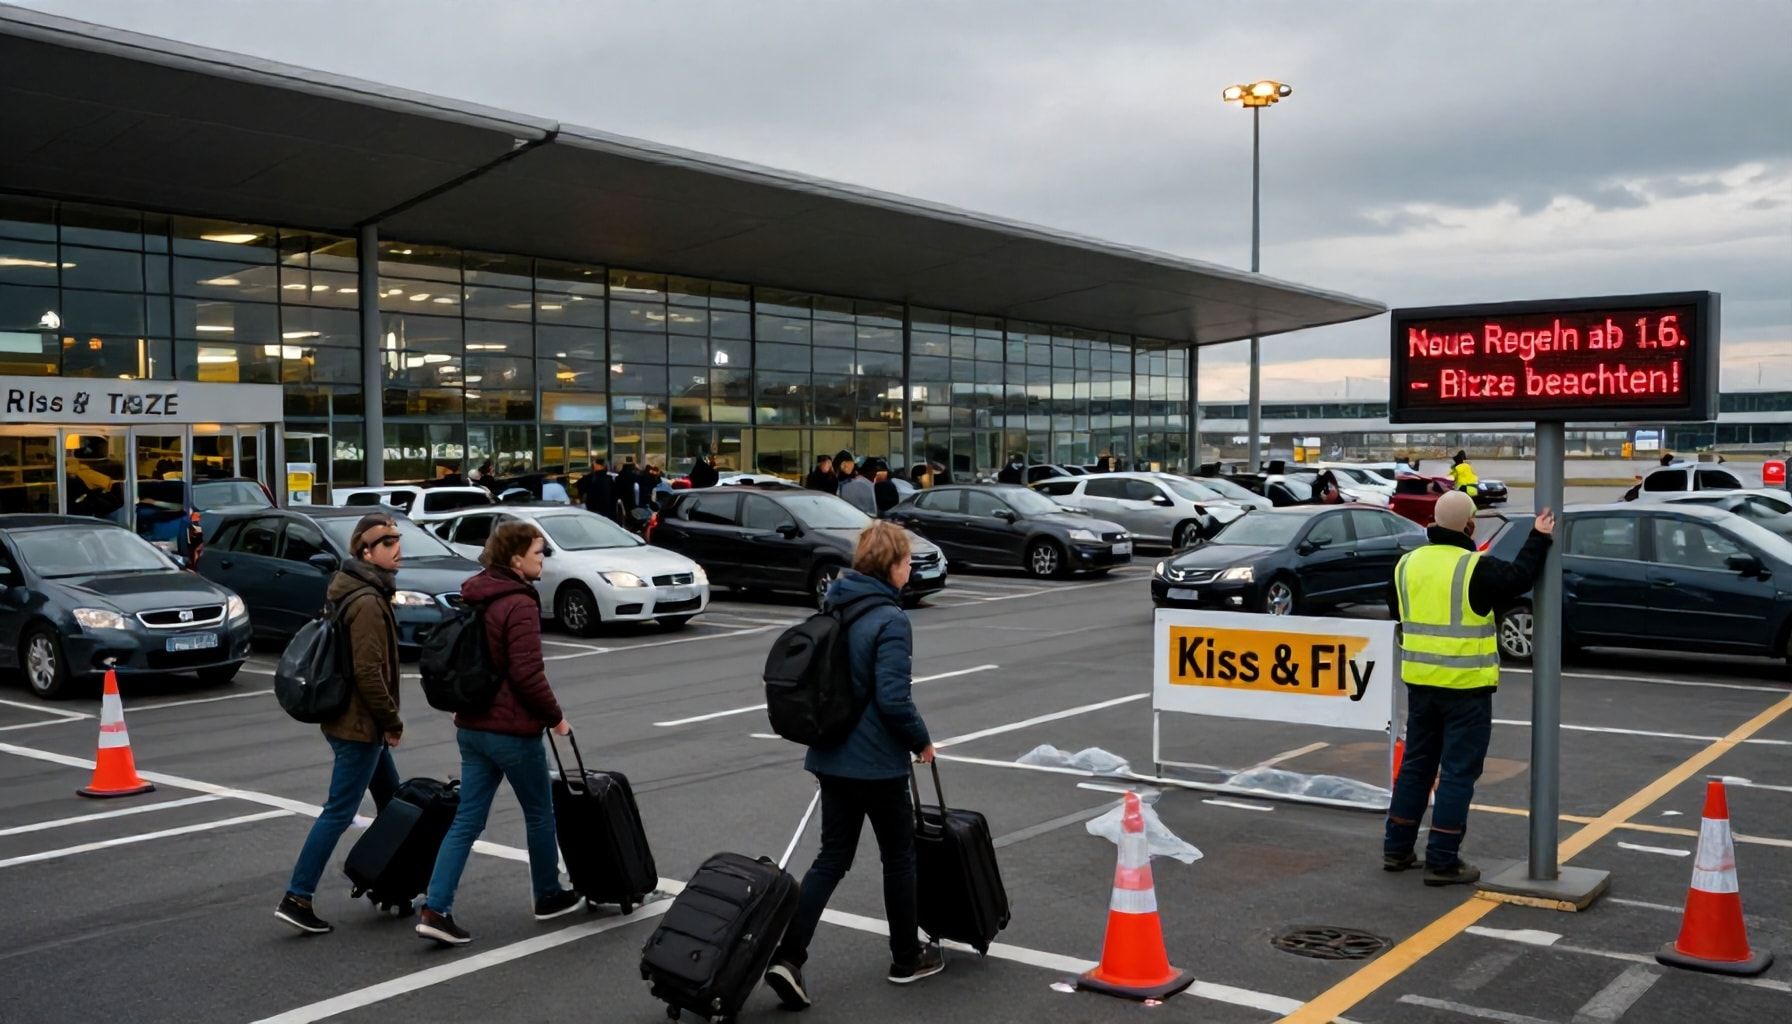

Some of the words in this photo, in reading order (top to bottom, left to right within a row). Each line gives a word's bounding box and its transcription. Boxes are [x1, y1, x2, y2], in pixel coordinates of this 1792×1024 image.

[1485, 319, 1578, 361] Regeln
[1589, 318, 1624, 349] ab
[1526, 360, 1679, 395] beachten!
[1178, 636, 1260, 683] Kiss
[1271, 643, 1300, 687] &
[1311, 644, 1376, 702] Fly
